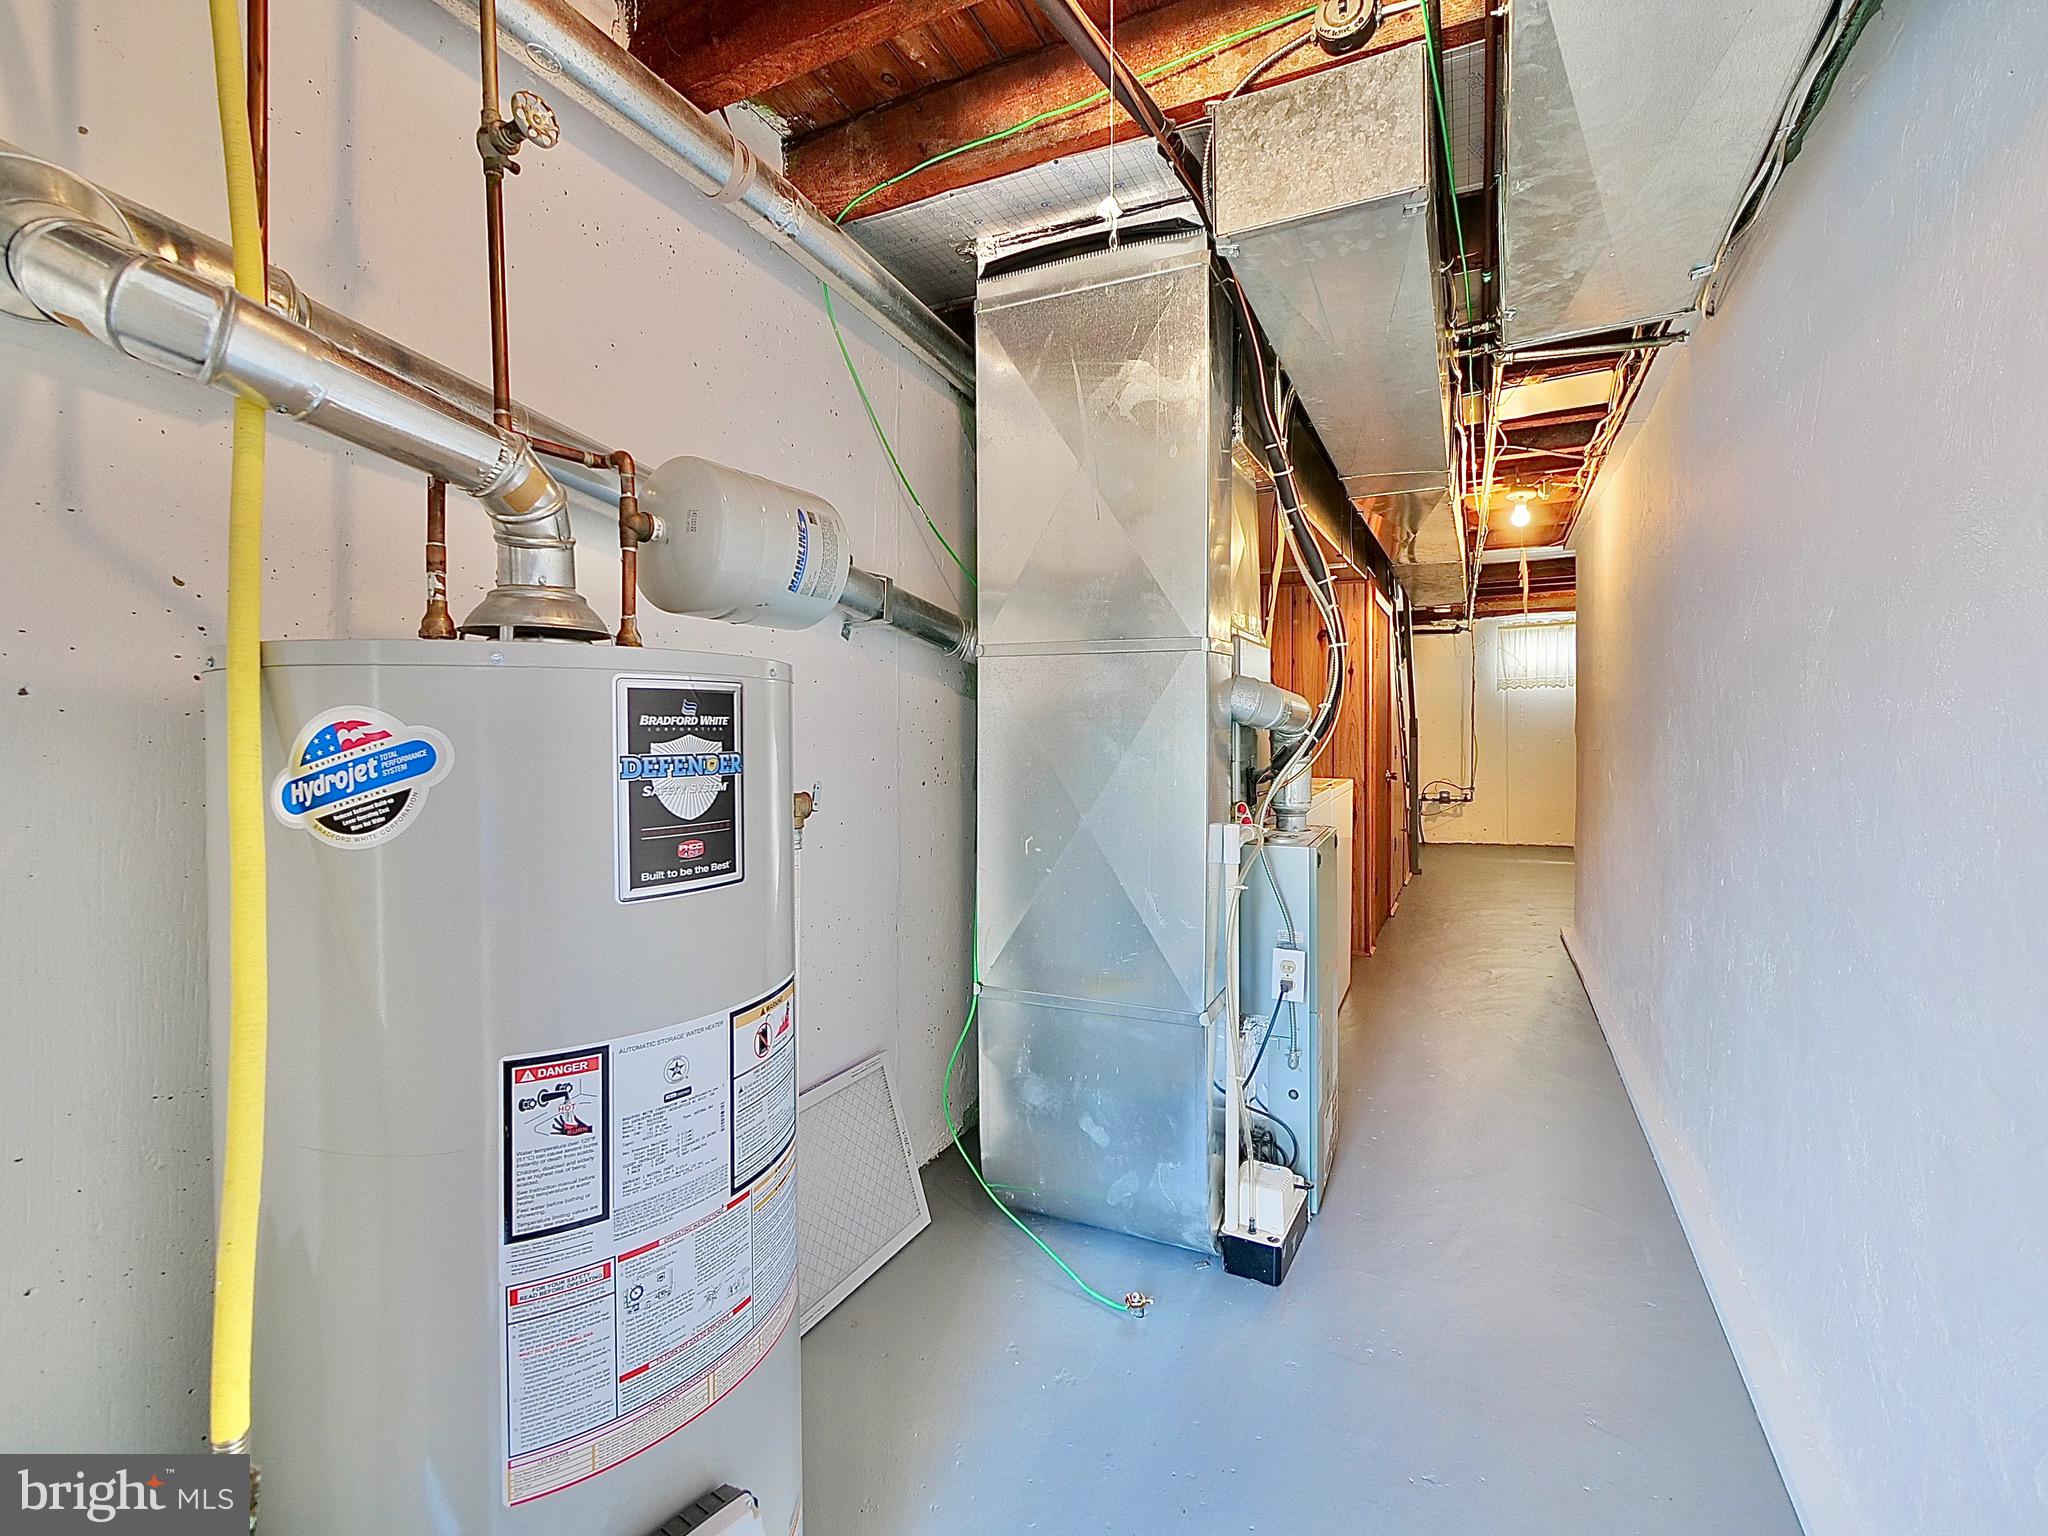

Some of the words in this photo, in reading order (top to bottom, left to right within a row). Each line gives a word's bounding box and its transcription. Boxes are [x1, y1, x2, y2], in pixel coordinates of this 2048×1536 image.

[788, 523, 808, 594] MAINLINE
[640, 714, 698, 726] BRADFORD
[700, 715, 730, 726] WHITE
[362, 742, 385, 752] WITH
[380, 750, 398, 761] TOTAL
[381, 749, 428, 769] PERFORMANCE
[383, 764, 408, 777] SYSTEM
[620, 752, 743, 780] DEFENDER
[290, 758, 378, 806] Hydrojet
[313, 823, 351, 843] BRADFORD
[354, 833, 378, 843] WHITE
[381, 791, 418, 836] CORPORATION
[641, 872, 665, 881] Built
[667, 870, 677, 878] to
[680, 867, 692, 876] be
[694, 865, 709, 873] the
[618, 1041, 656, 1054] AUTOMATIC
[657, 1033, 684, 1046] STORAGE
[537, 1062, 588, 1077] DANGER
[558, 1104, 575, 1112] HOT
[540, 1286, 564, 1296] BEFORE
[566, 1273, 602, 1288] OPERATING
[566, 1273, 591, 1283] SAFETY
